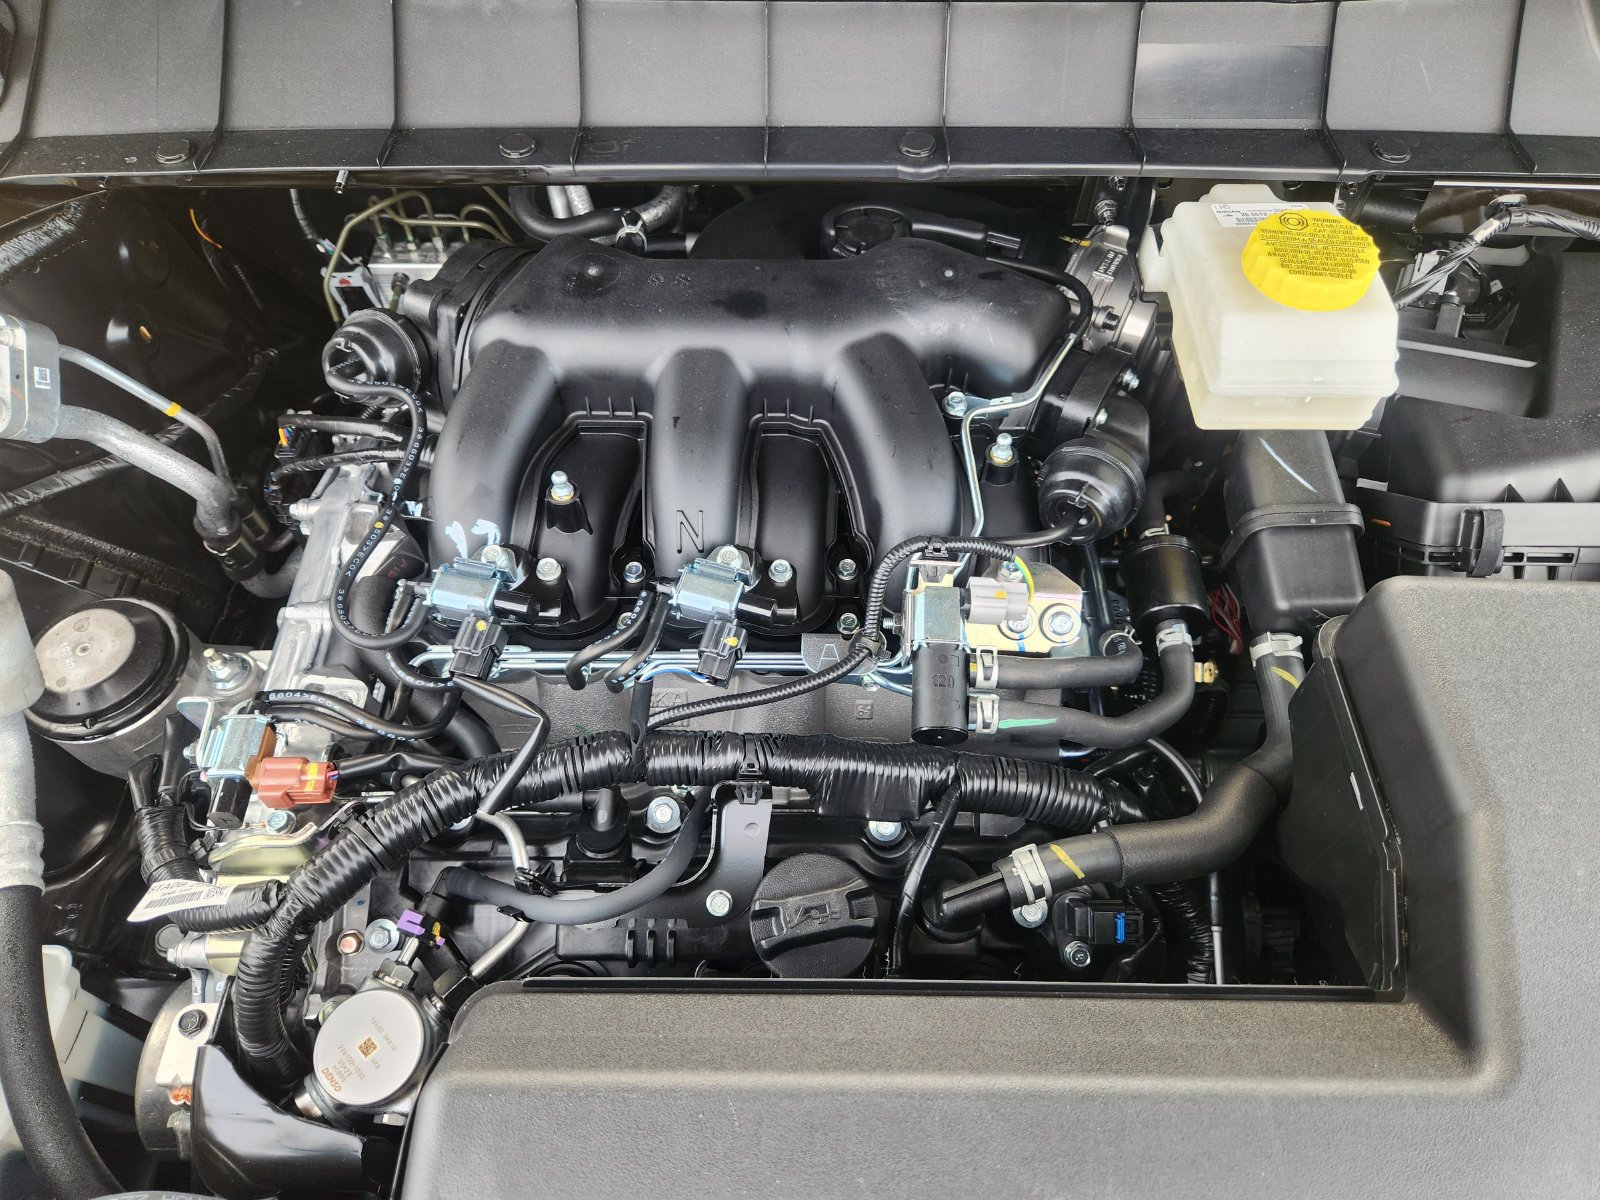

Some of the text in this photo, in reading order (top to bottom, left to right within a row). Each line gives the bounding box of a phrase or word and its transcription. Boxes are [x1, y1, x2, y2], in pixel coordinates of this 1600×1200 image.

[676, 510, 704, 554] N
[816, 644, 840, 672] A
[932, 674, 954, 688] 120
[322, 1068, 342, 1092] DENSO
